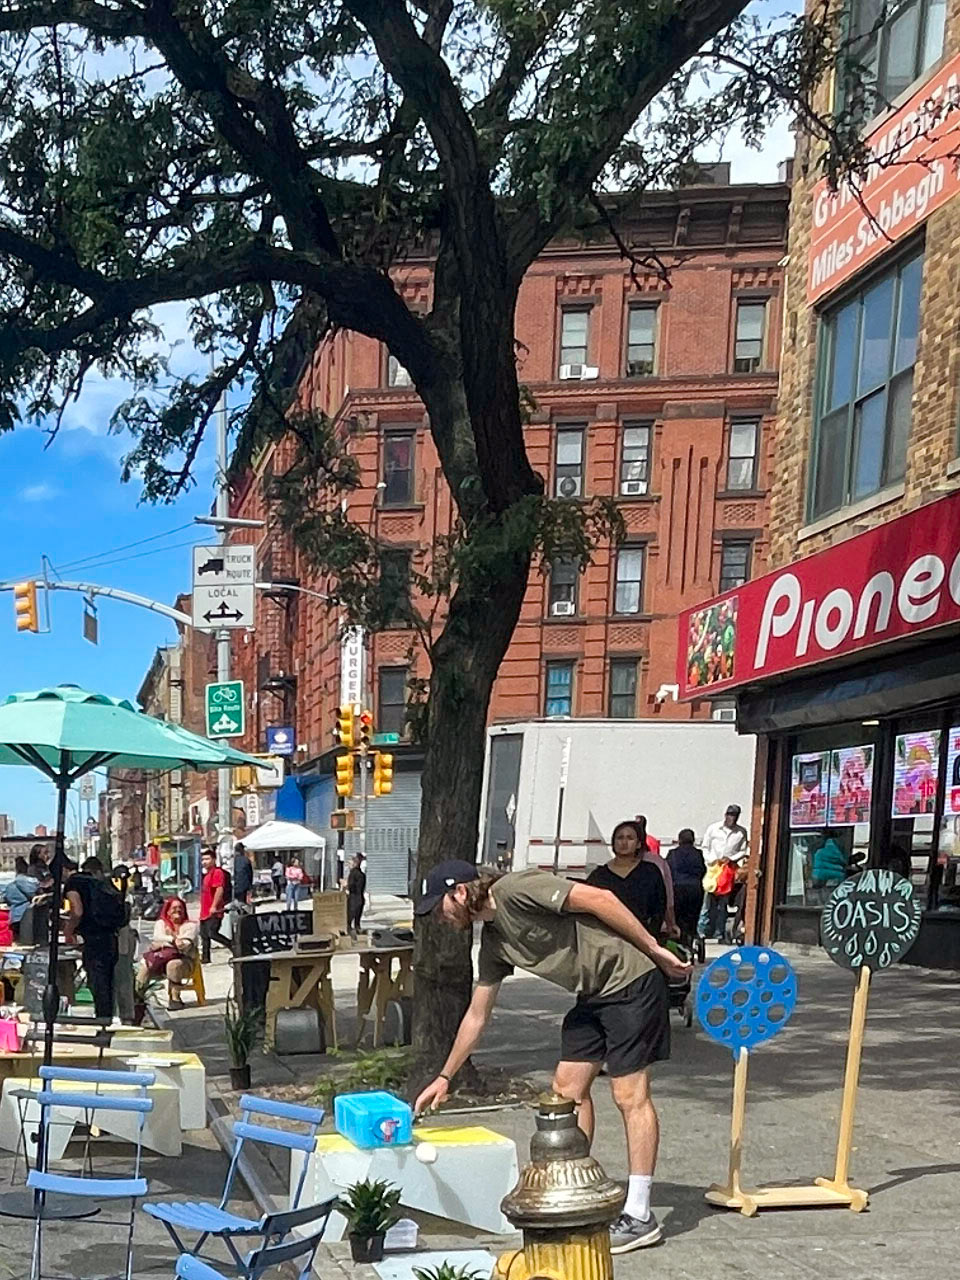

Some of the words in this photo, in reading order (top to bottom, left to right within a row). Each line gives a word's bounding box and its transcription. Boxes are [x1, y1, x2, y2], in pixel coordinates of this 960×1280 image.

[811, 235, 854, 290] Miles
[855, 160, 944, 255] Sabbagh
[226, 555, 252, 563] TRUCK
[226, 569, 252, 578] ROUTE
[208, 589, 239, 598] LOCAL
[753, 551, 960, 670] Pione
[257, 913, 307, 932] WRITE
[833, 899, 909, 932] OASIS
